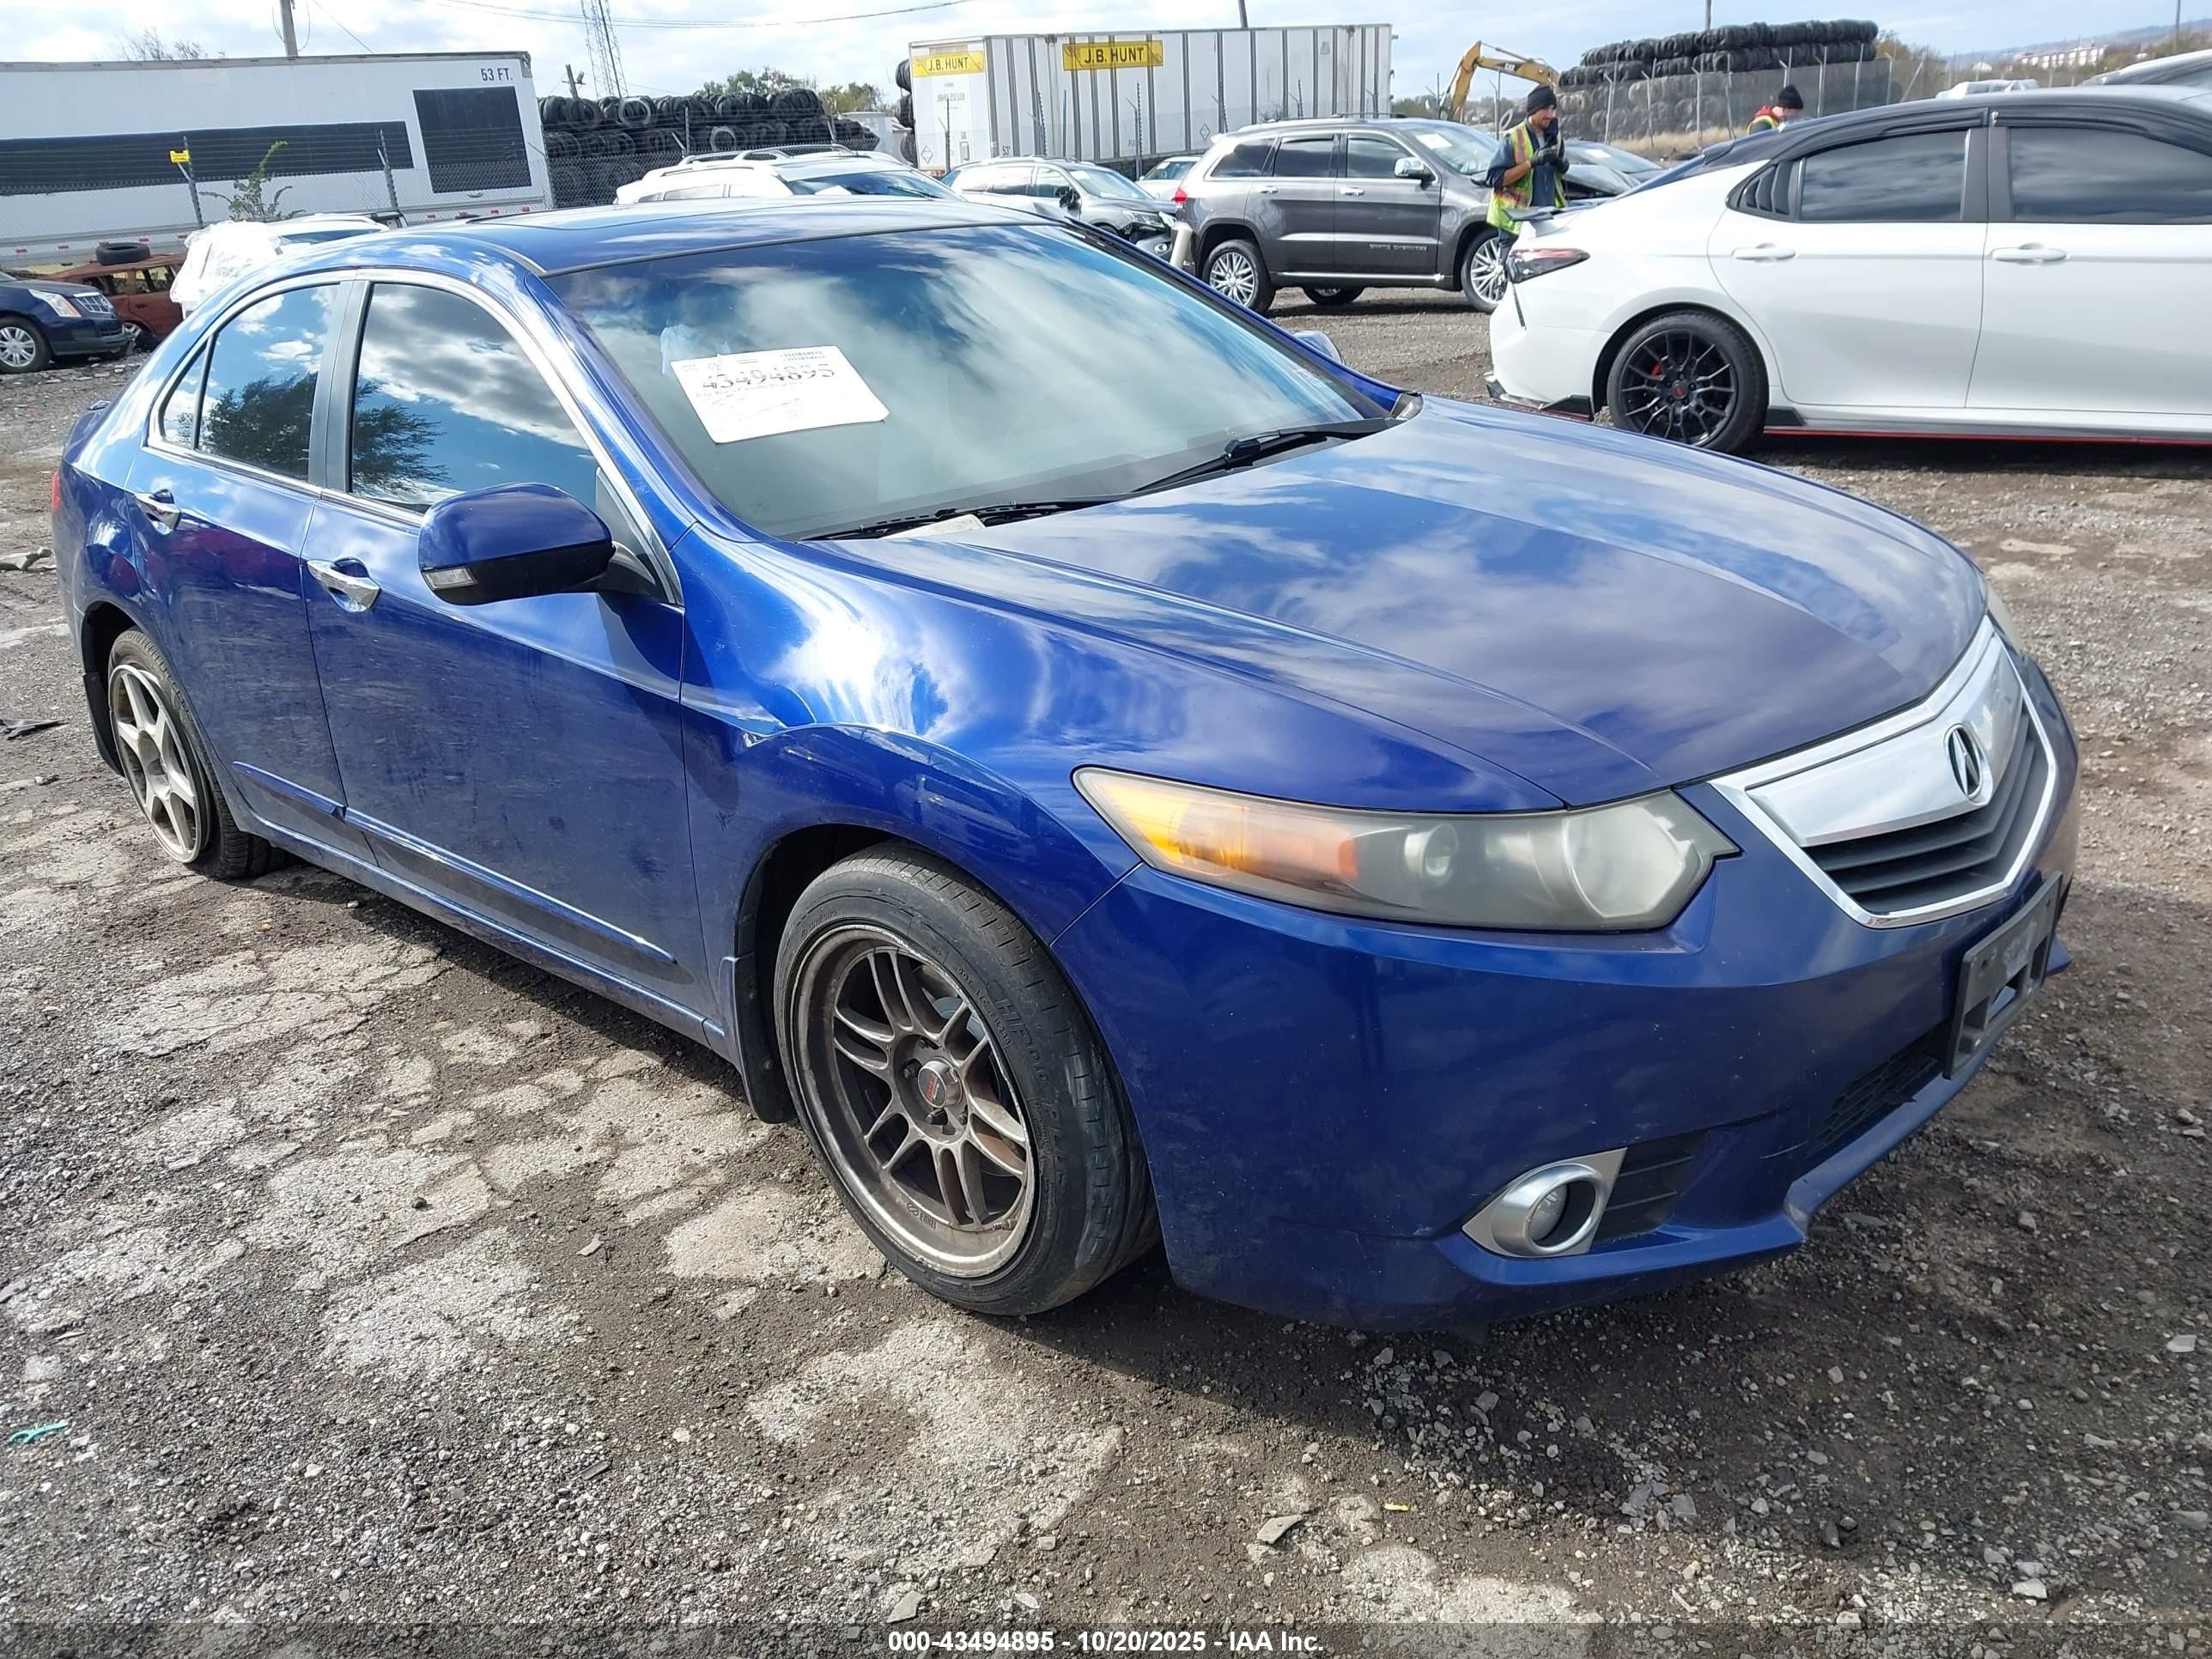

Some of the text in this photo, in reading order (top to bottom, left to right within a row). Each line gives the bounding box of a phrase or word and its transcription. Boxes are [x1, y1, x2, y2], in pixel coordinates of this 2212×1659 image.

[1084, 46, 1145, 64] J.B. HUNT
[928, 57, 969, 71] J.B. HUNT
[481, 68, 495, 82] 53
